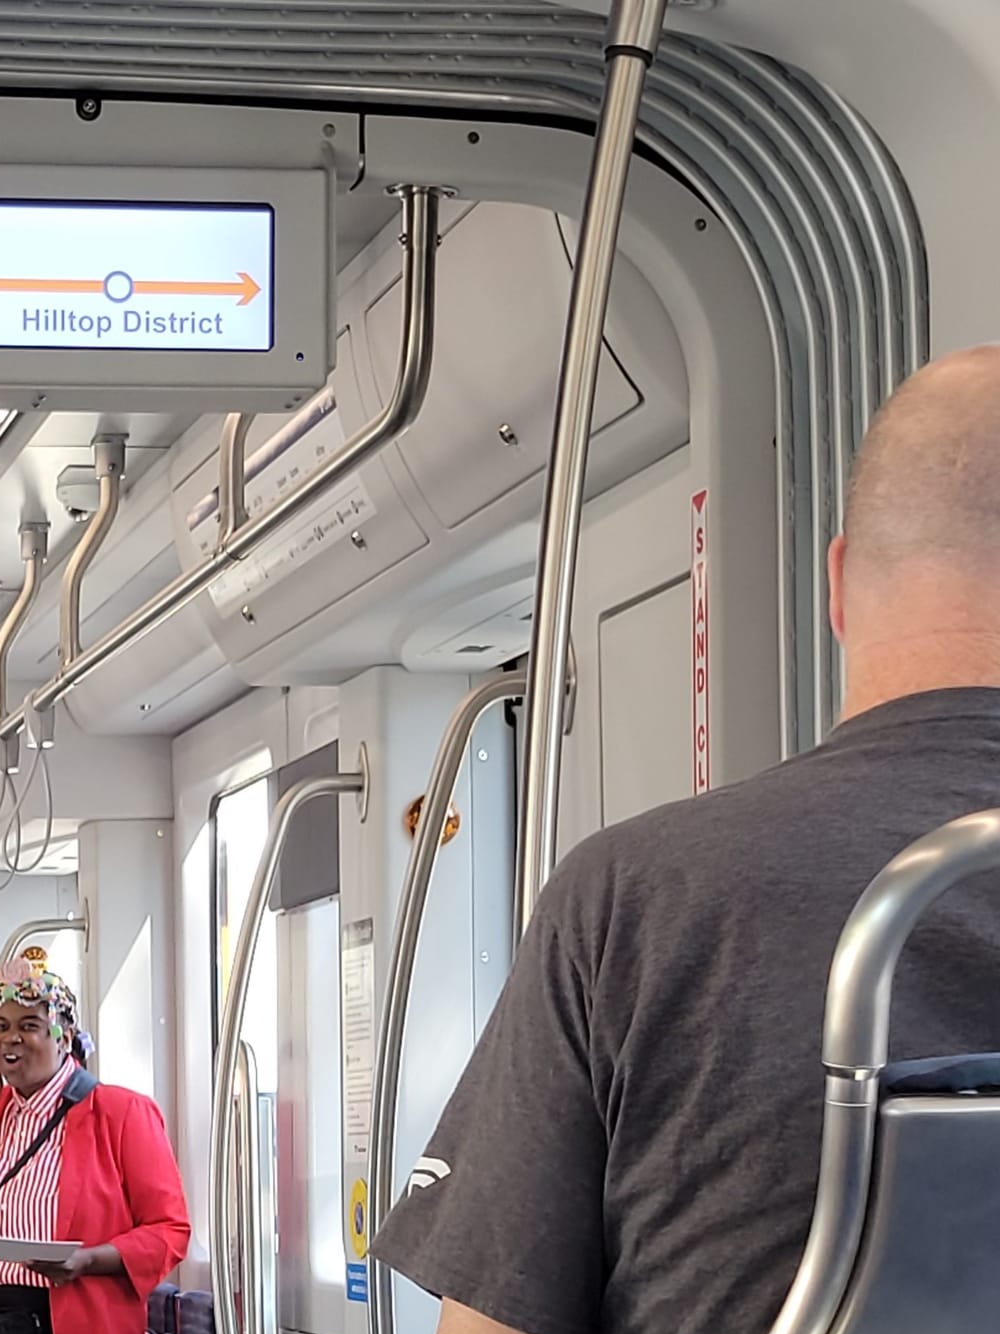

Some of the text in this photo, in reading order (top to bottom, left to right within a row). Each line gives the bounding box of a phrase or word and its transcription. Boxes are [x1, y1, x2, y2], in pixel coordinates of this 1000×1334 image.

[21, 309, 223, 338] Hilltop District
[695, 526, 705, 694] STAND
